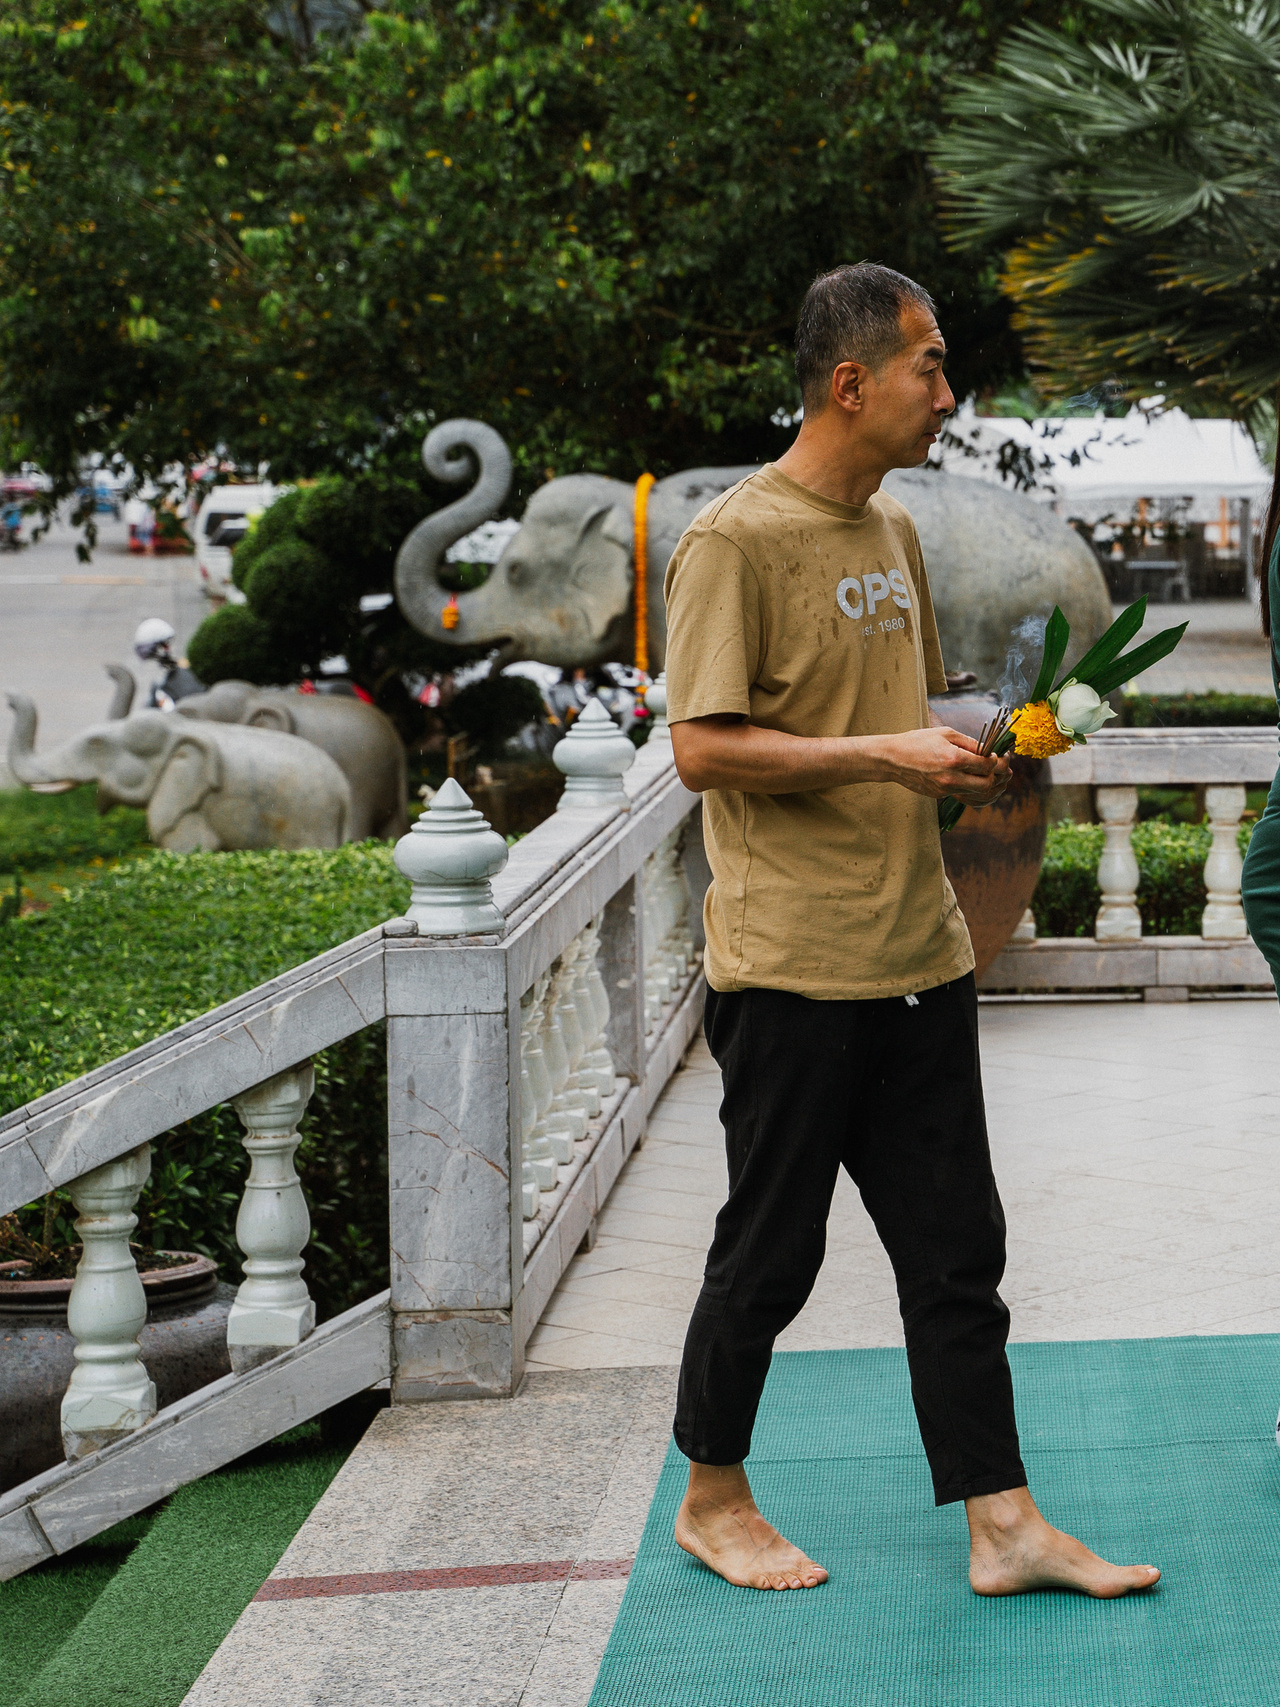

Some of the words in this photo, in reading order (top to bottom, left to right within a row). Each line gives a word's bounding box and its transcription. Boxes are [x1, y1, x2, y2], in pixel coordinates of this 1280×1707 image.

[836, 568, 912, 620] CPS
[861, 624, 876, 637] est.
[878, 616, 906, 633] 1980
